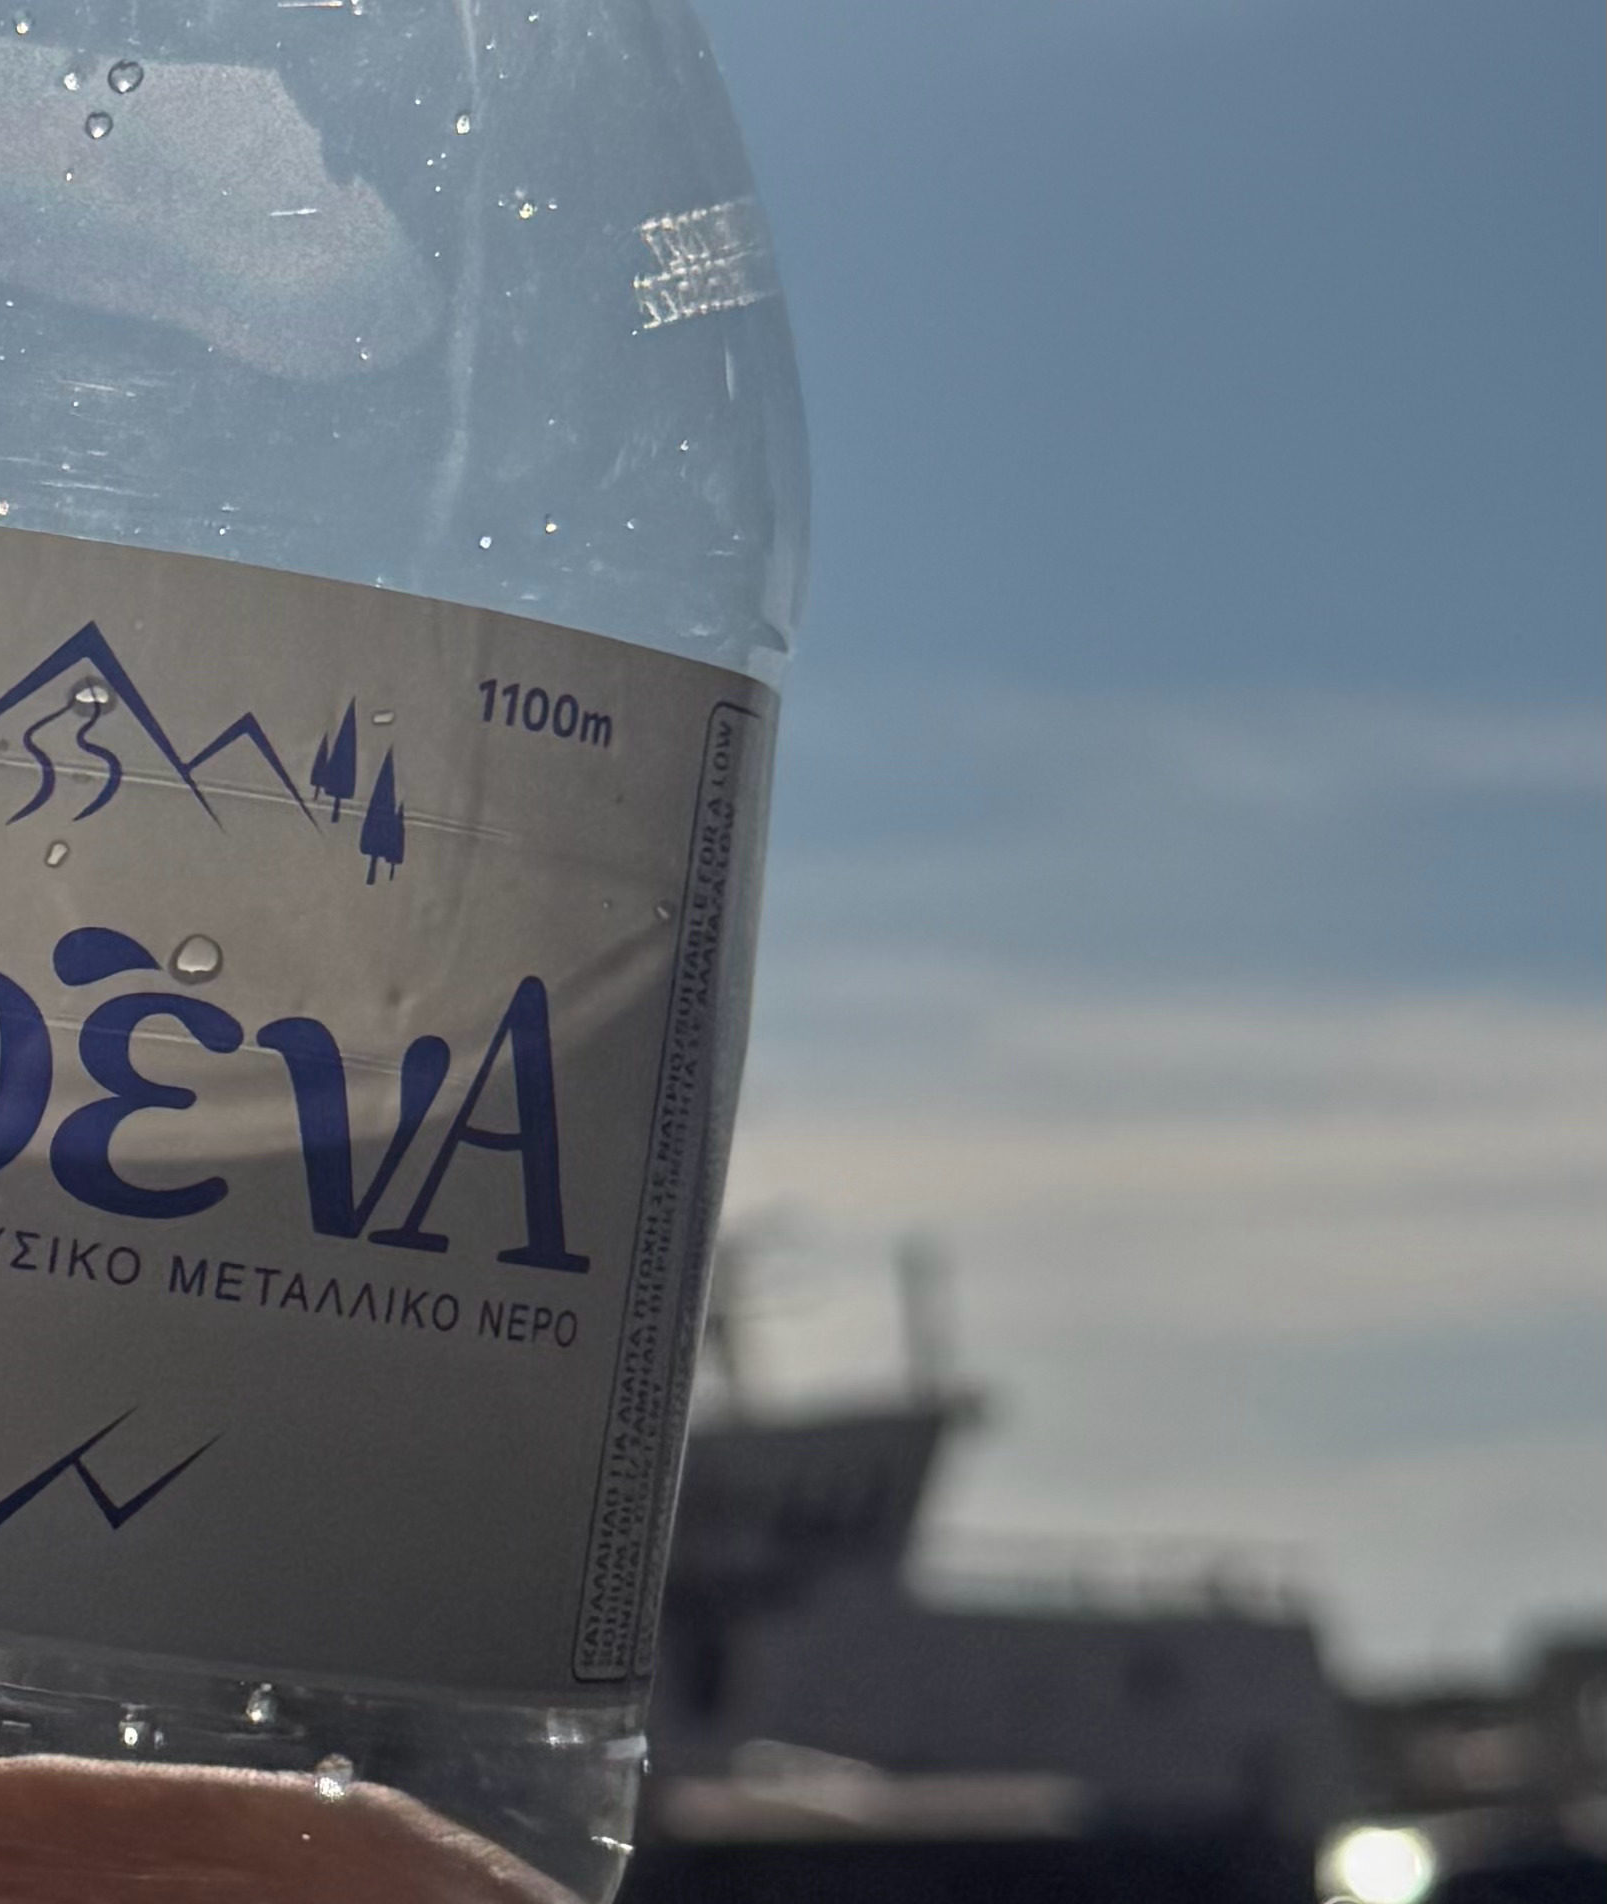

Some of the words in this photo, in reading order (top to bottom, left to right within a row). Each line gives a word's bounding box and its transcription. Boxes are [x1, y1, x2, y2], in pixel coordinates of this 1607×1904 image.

[479, 679, 612, 748] 1100m
[168, 1255, 460, 1332] ΜΕΤΑΛΛΙΚΟ
[478, 1300, 578, 1348] ΝΕΡΟ
